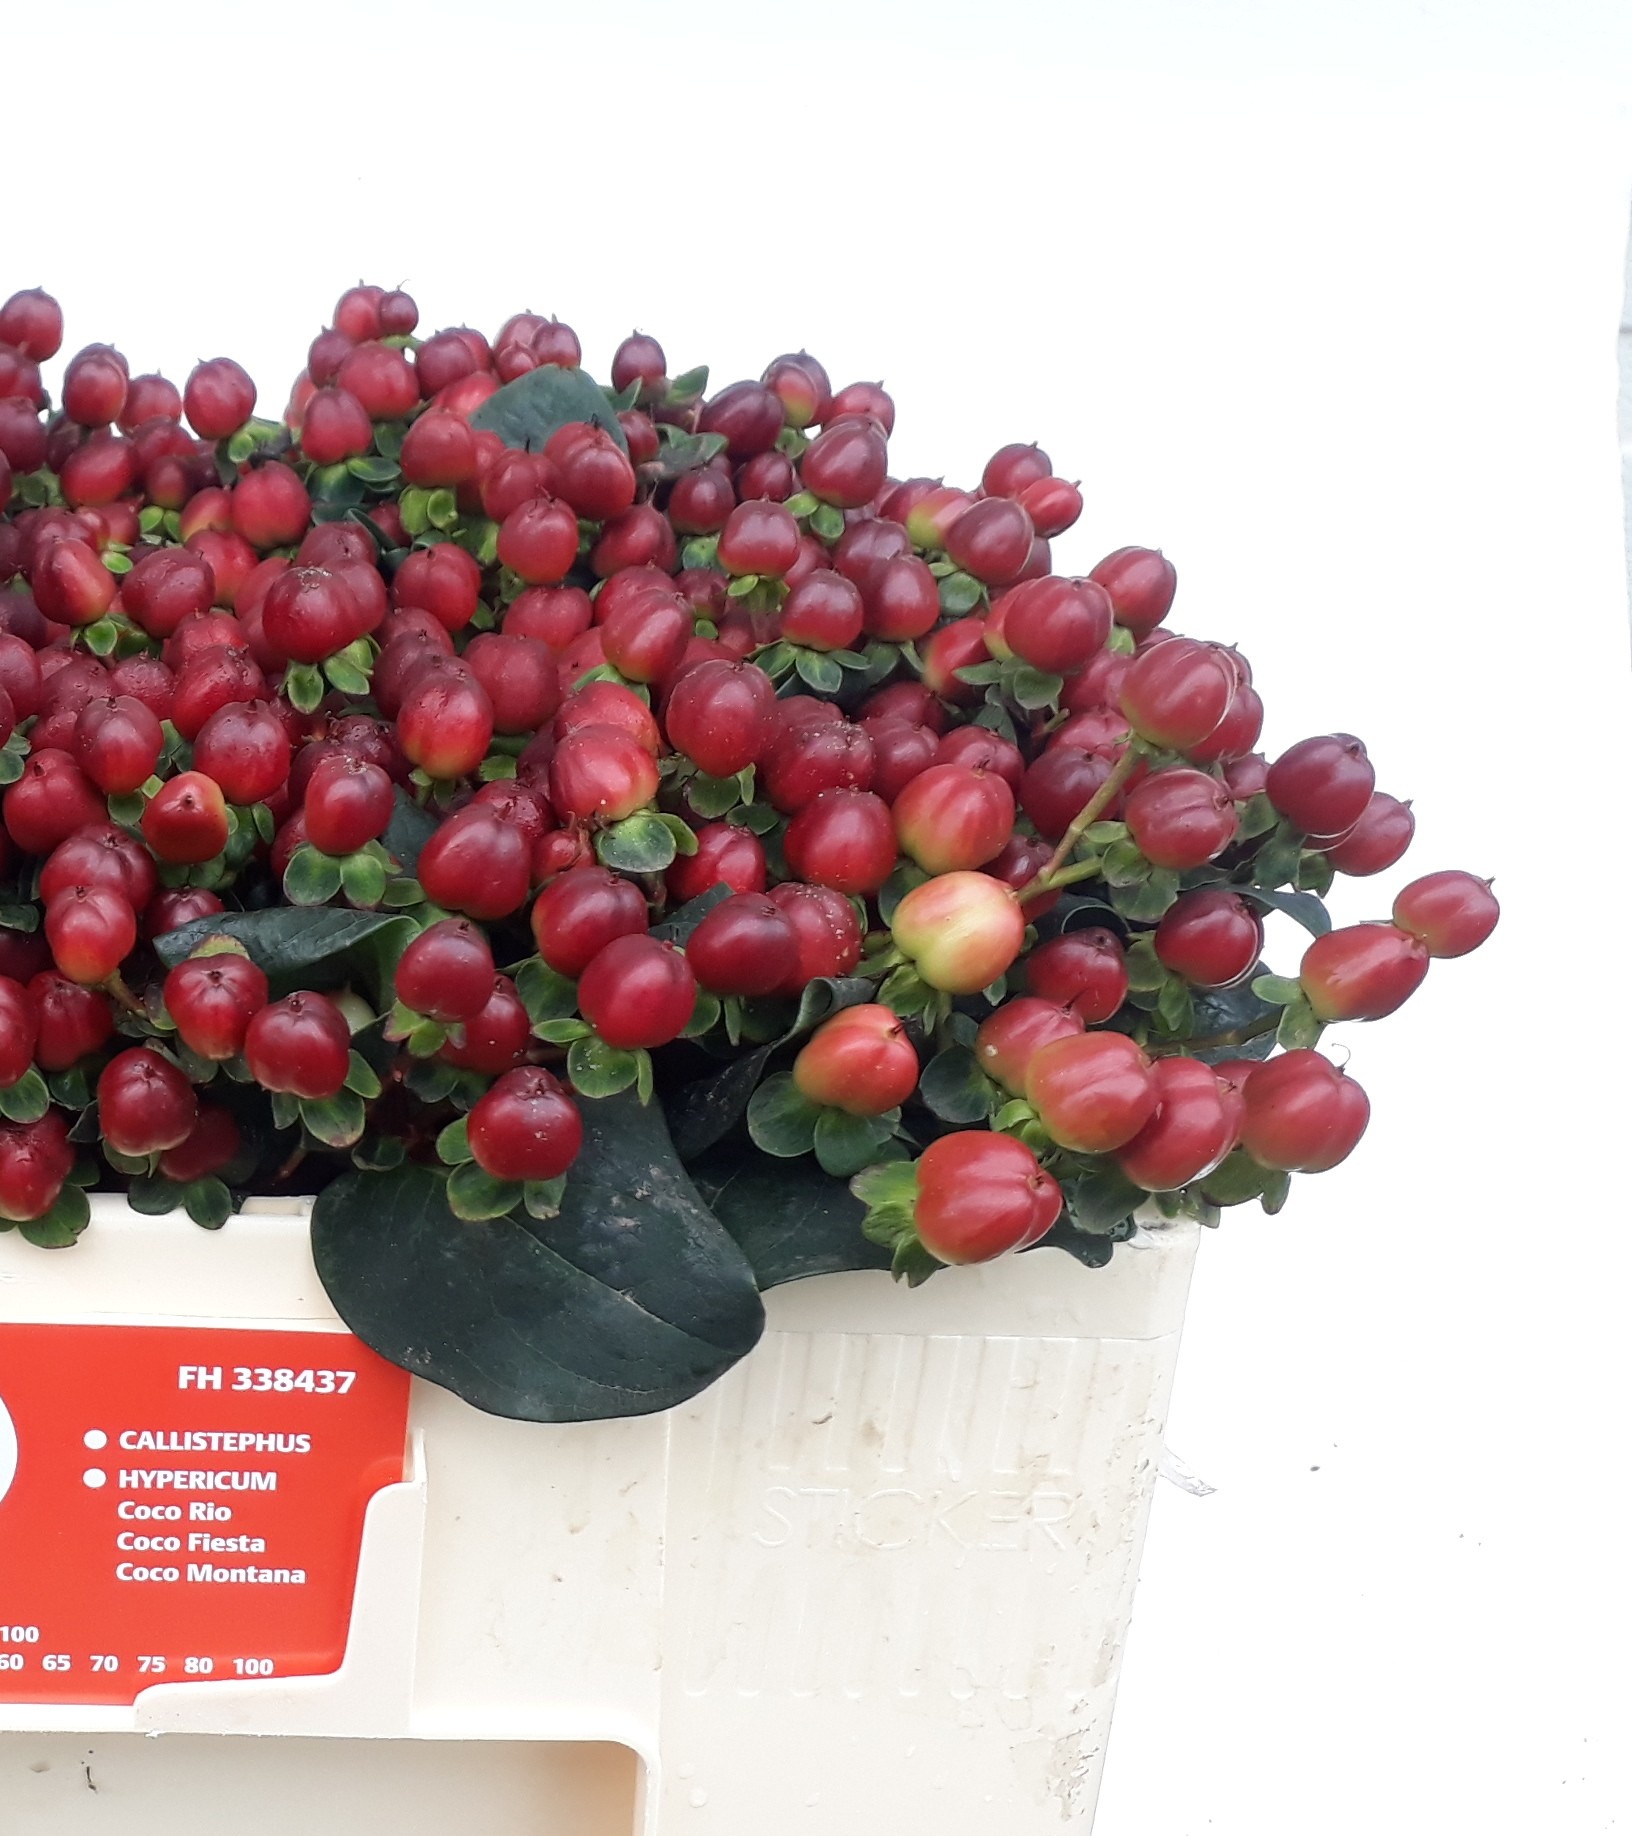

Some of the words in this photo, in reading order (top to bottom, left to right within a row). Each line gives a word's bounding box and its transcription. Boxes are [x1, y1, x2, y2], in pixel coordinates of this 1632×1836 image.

[178, 1365, 223, 1391] FH
[231, 1367, 357, 1395] 338437
[118, 1430, 311, 1454] CALLISTEPHUS
[118, 1469, 278, 1492] HYPERICUM
[117, 1500, 183, 1521] Coco
[188, 1501, 232, 1522] Rio
[116, 1531, 181, 1553] Coco
[187, 1532, 266, 1553] Fiesta
[115, 1562, 180, 1583] Coco
[186, 1563, 306, 1585] Montana
[41, 1654, 72, 1672] 65
[89, 1655, 119, 1673] 70
[136, 1655, 167, 1673] 75
[183, 1656, 214, 1674] 80
[231, 1657, 274, 1675] 100
